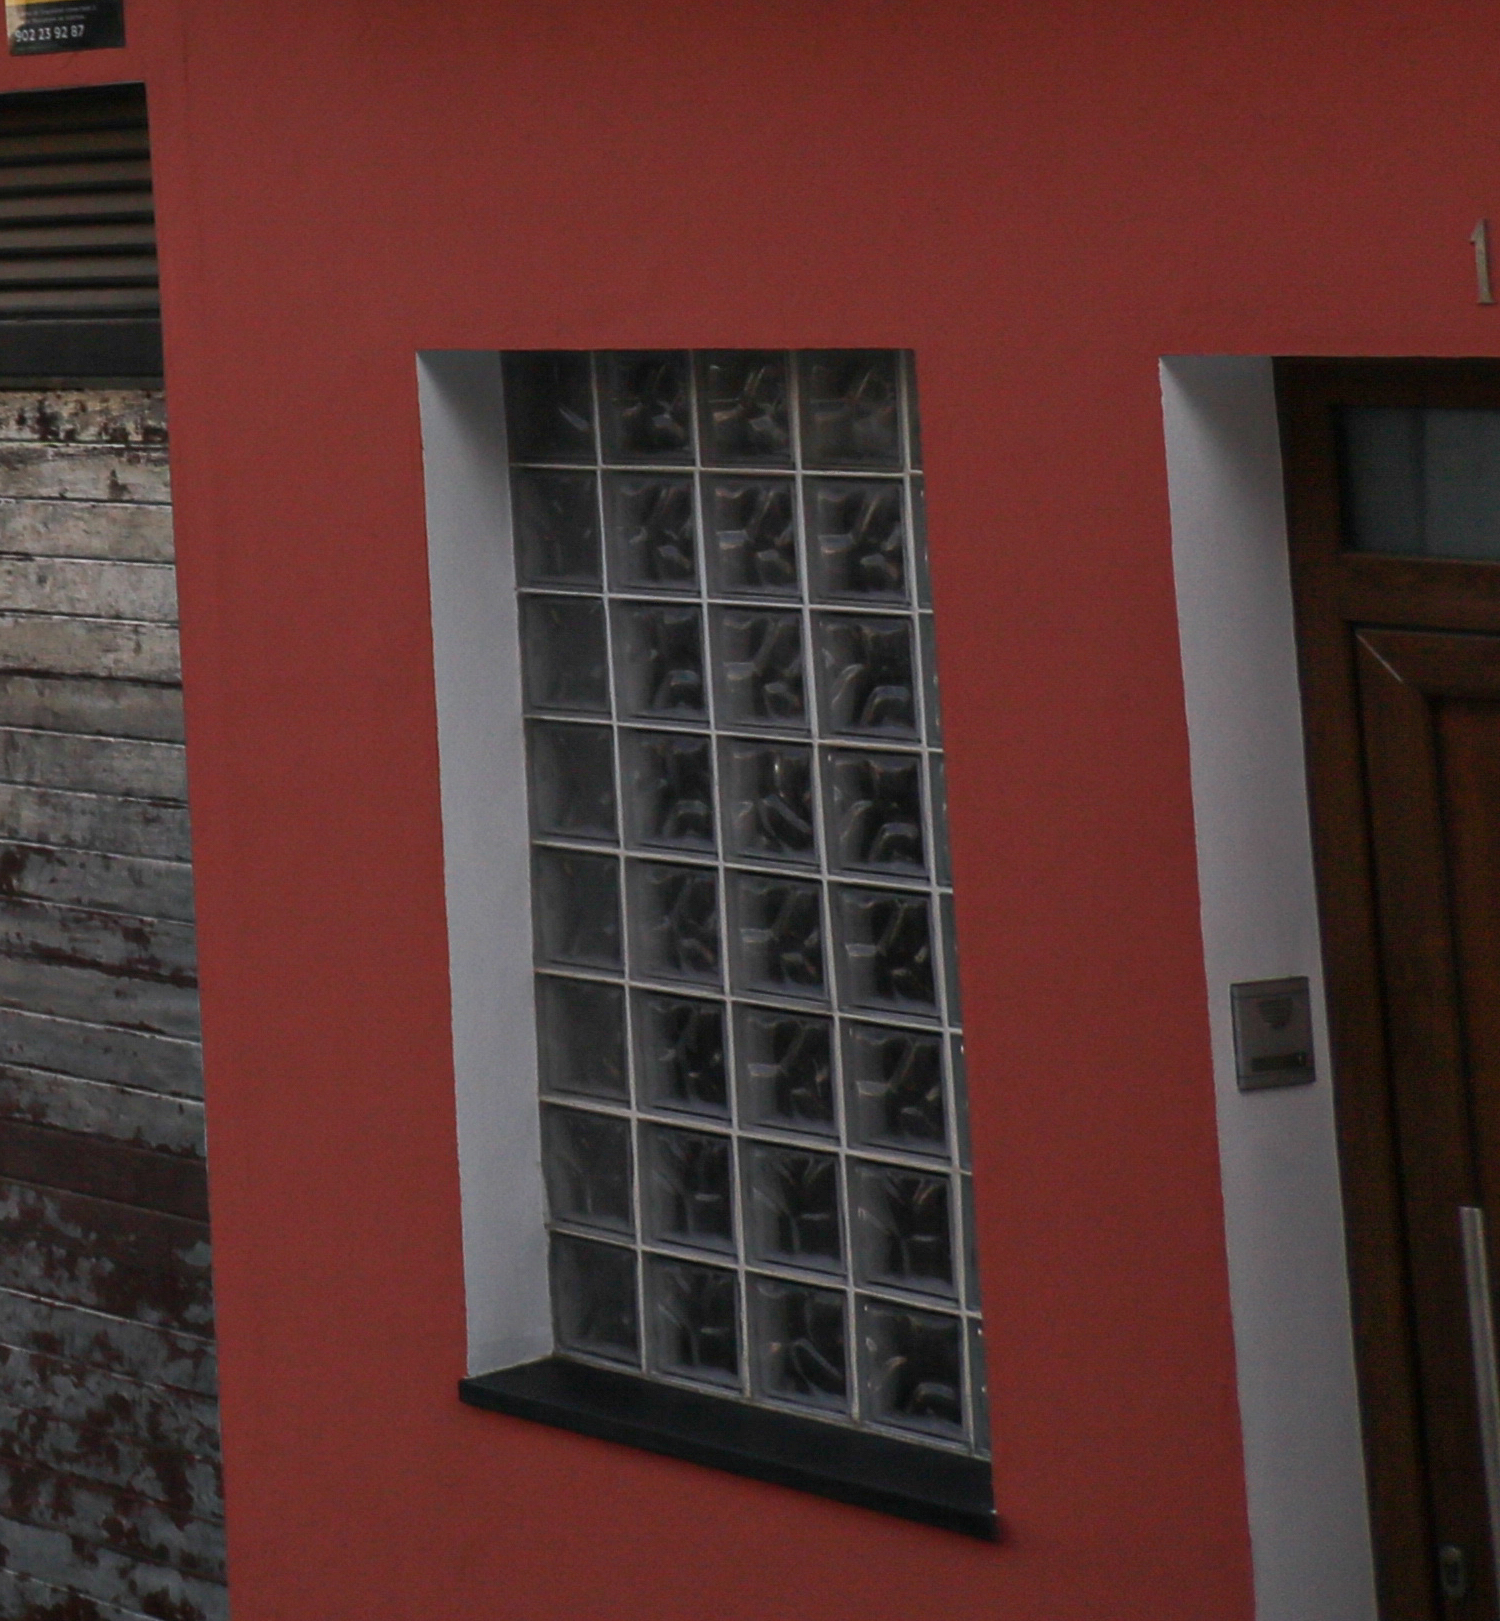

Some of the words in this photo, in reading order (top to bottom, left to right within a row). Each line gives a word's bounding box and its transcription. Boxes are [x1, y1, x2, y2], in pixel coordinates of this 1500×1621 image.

[15, 28, 36, 43] 902
[38, 27, 52, 41] 23
[53, 25, 68, 39] 92
[70, 24, 85, 38] 87
